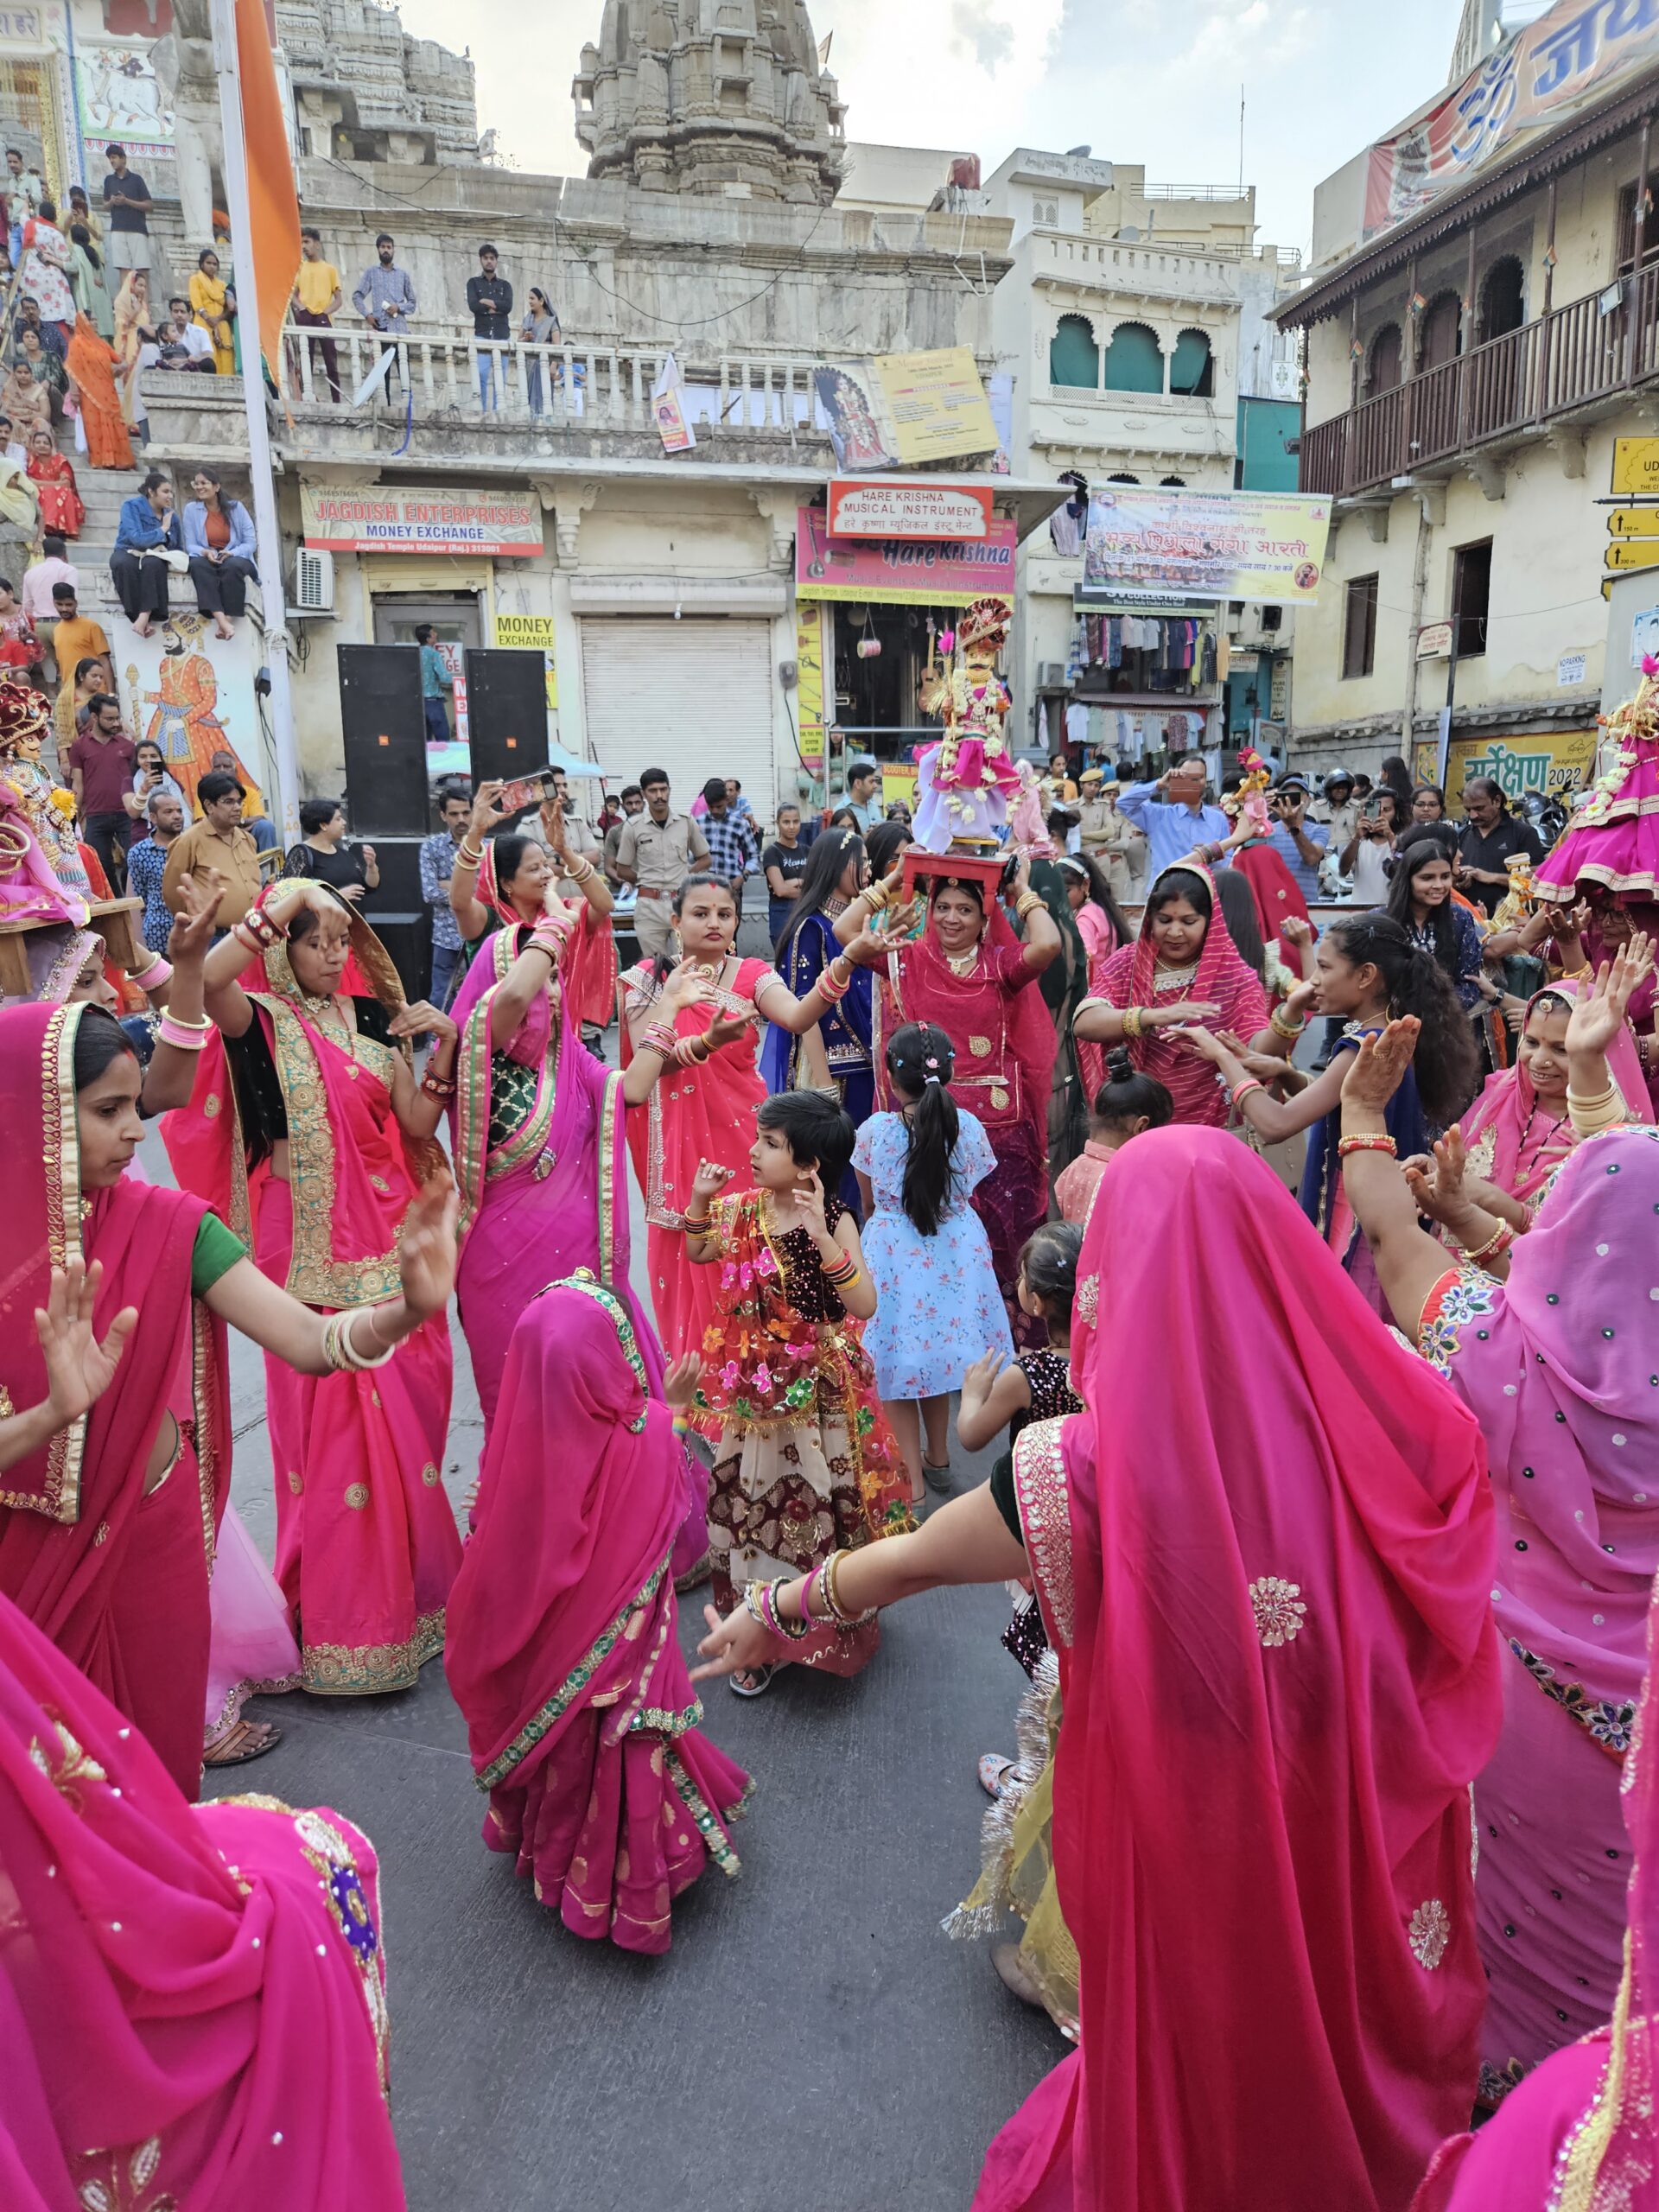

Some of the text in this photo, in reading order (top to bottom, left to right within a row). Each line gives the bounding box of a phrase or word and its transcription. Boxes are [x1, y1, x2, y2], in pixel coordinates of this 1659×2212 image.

[862, 492, 944, 503] HARE KRISHNA
[314, 500, 531, 526] JAGDISH ENTERPRISES
[844, 503, 978, 517] MUSICAL INSTRUMENT
[844, 517, 855, 529] हरे
[366, 525, 484, 540] MONEY EXCHANGE
[355, 542, 385, 550] Jagdish
[386, 543, 415, 552] Temple
[416, 543, 447, 553] Udaipur
[938, 541, 1010, 565] Krishna
[1210, 535, 1249, 554] गंगा
[1255, 539, 1309, 558] आरती
[498, 618, 552, 632] MONEY
[499, 635, 553, 646] EXCHANGE
[1549, 767, 1581, 785] 2022
